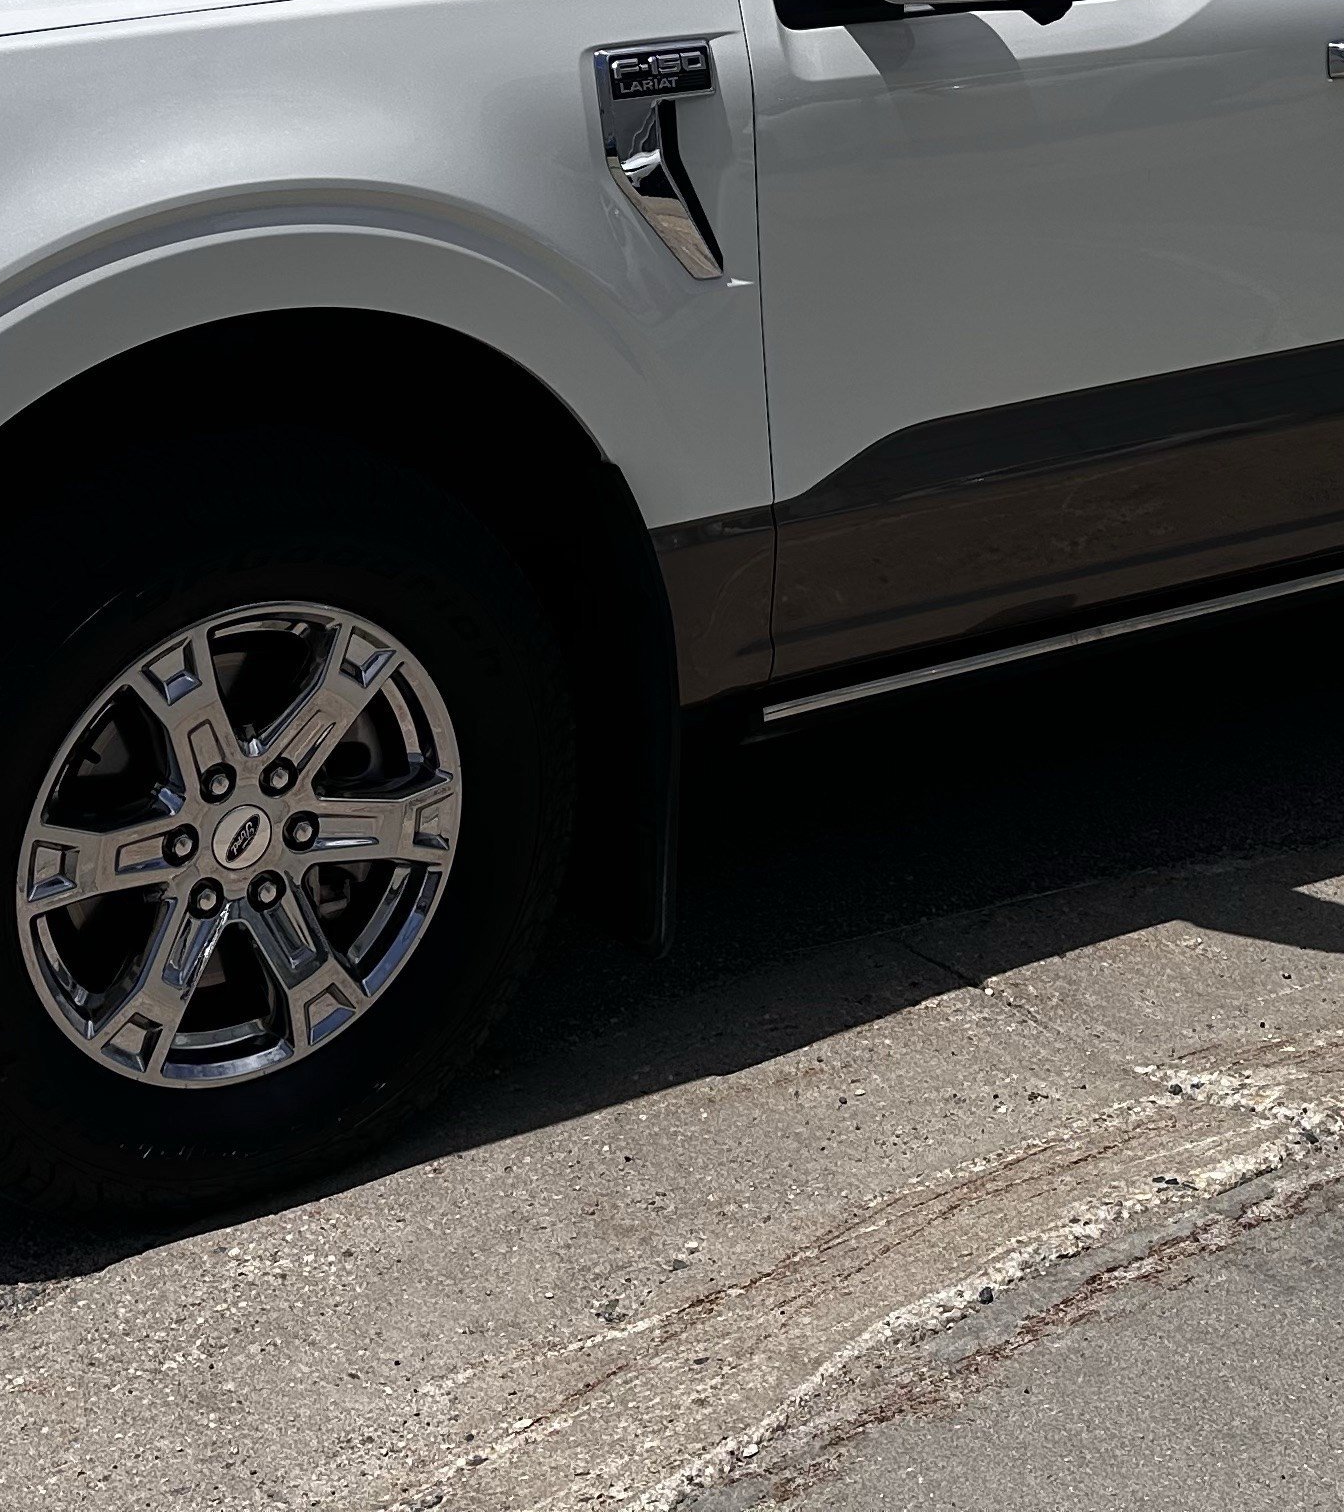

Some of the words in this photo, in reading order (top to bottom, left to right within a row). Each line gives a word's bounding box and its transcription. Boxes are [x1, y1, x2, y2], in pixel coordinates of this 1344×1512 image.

[612, 51, 706, 79] F-150
[620, 77, 678, 94] LARIAT
[231, 822, 255, 855] Ford
